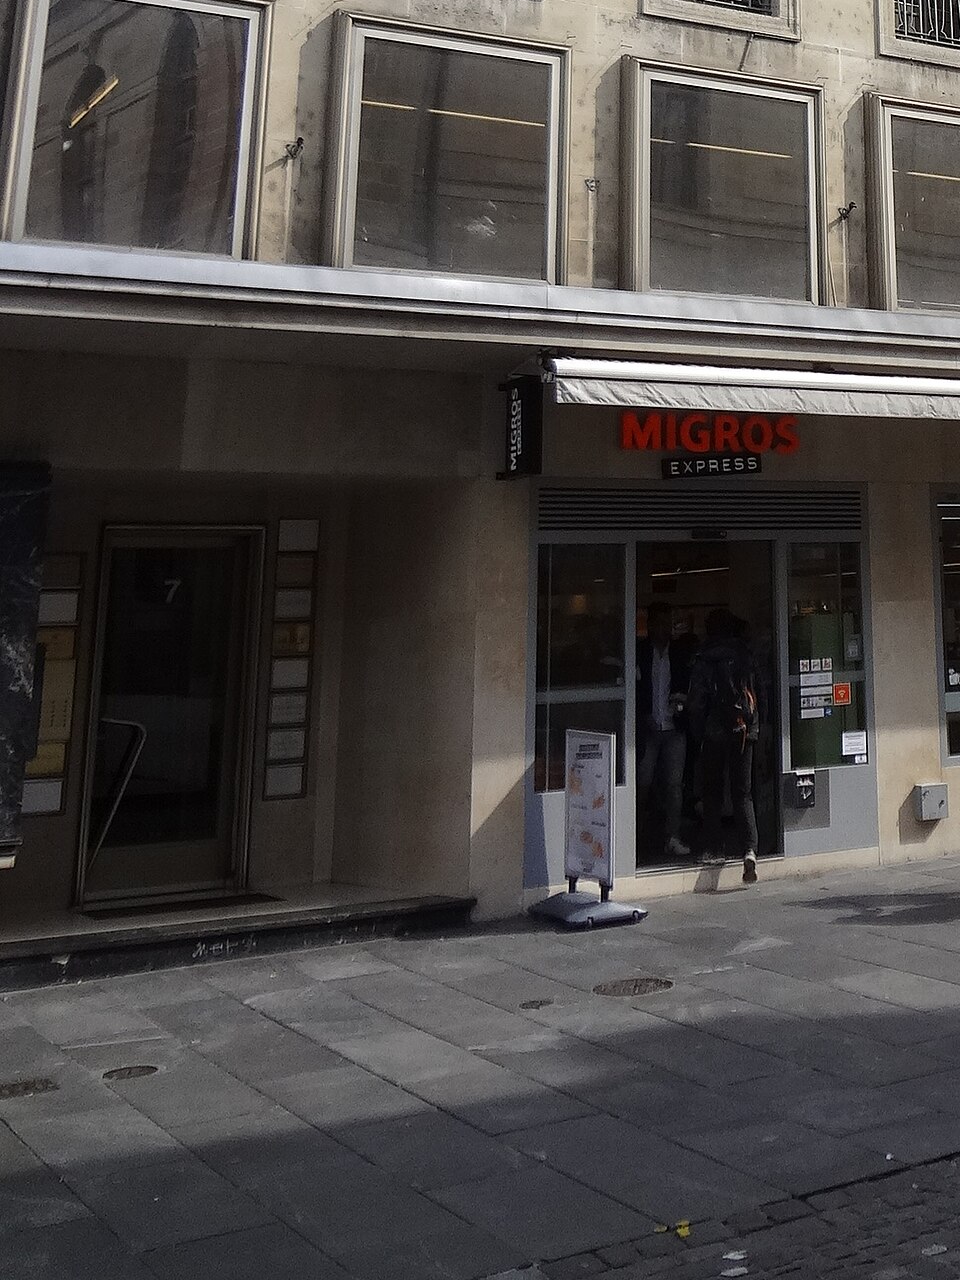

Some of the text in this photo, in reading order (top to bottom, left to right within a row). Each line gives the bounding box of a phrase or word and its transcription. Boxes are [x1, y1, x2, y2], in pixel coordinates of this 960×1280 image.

[621, 411, 801, 455] MIGROS
[670, 457, 758, 475] EXPRESS
[164, 578, 181, 604] 7
